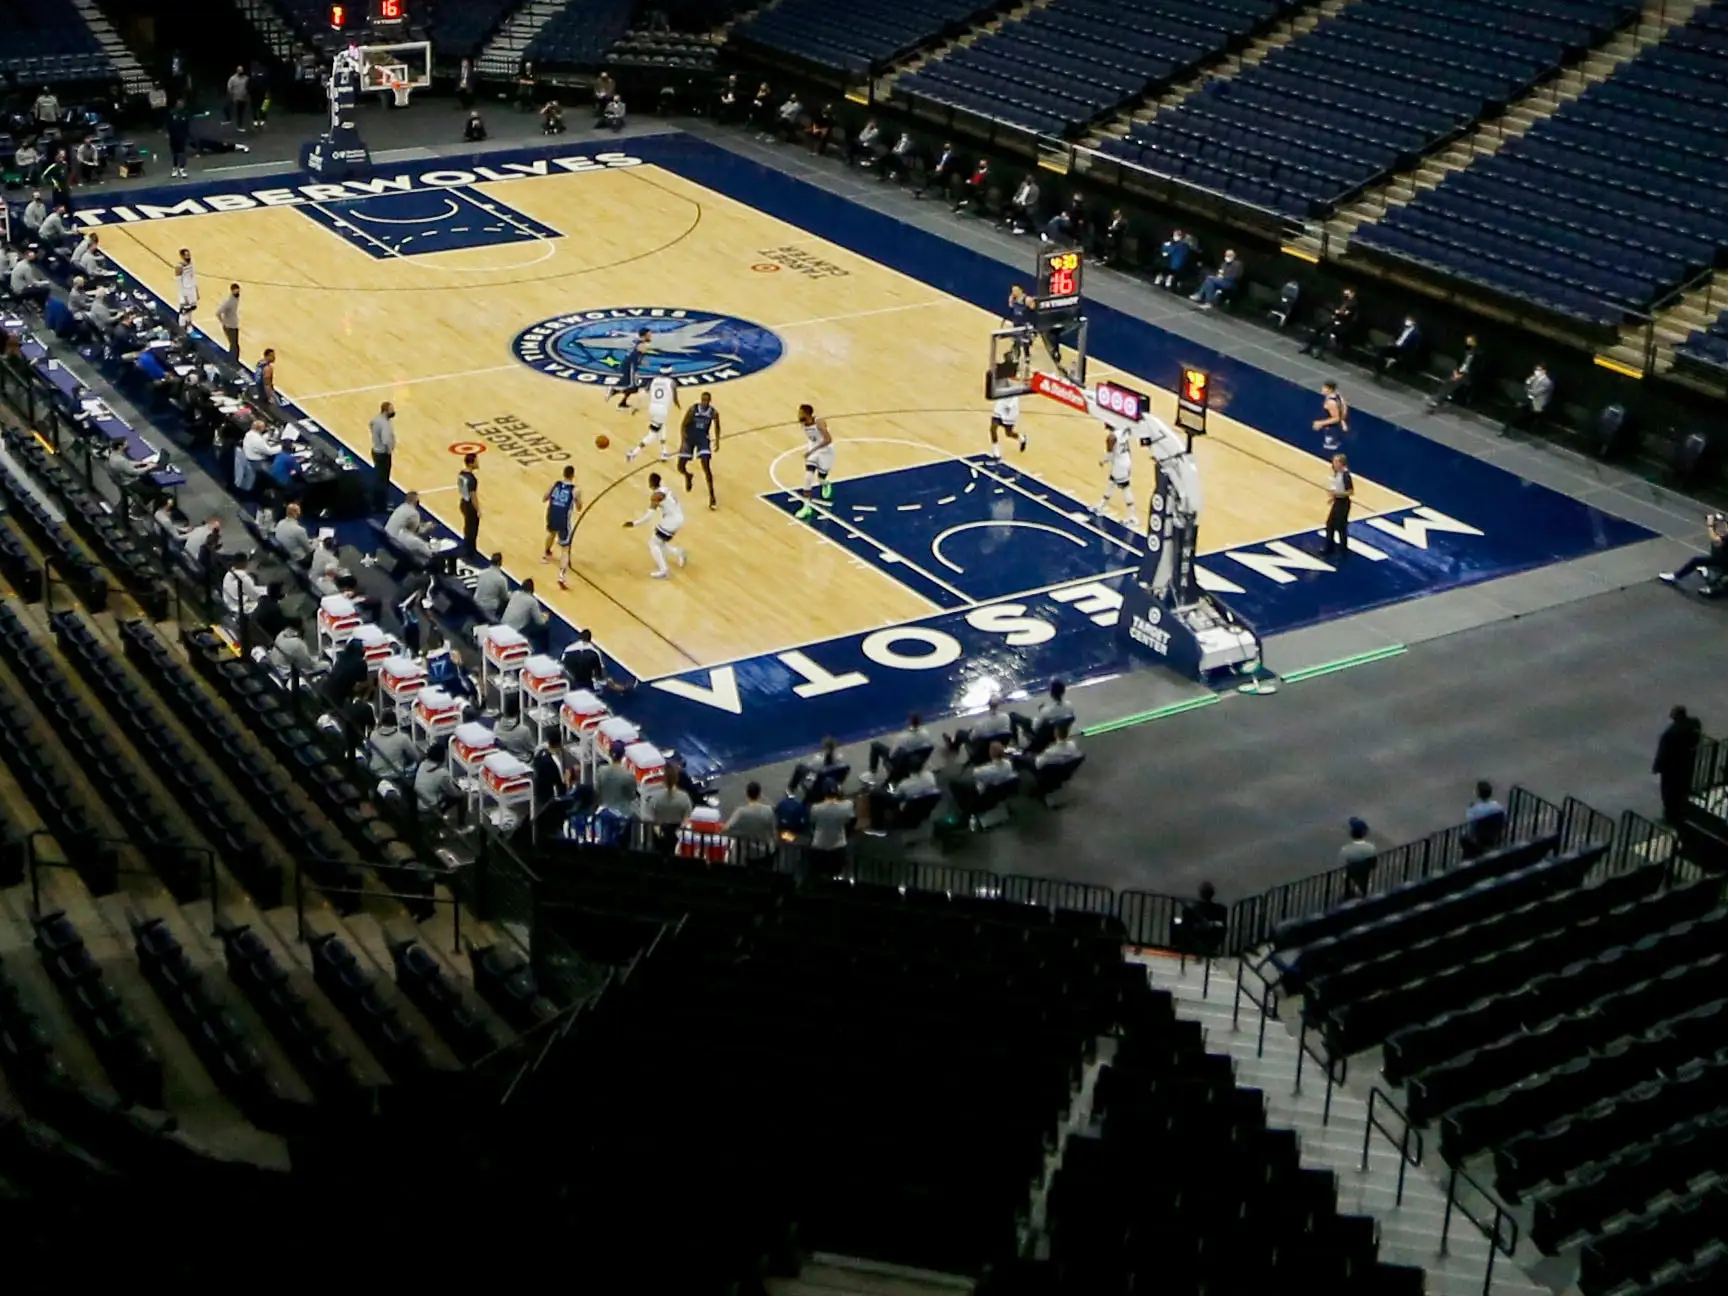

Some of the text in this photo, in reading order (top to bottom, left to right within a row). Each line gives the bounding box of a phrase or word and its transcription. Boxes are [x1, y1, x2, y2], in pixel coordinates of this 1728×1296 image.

[382, 1, 398, 17] 16
[71, 151, 645, 229] TIMBERWOLVES
[1049, 269, 1076, 296] 16
[519, 307, 689, 363] TIMBERWOLVES
[543, 361, 742, 386] MINSOTA
[653, 387, 664, 400] 0
[464, 420, 544, 468] TARGET
[493, 413, 572, 462] CENTER
[1128, 626, 1169, 658] CENTER
[1131, 614, 1172, 644] TARGET
